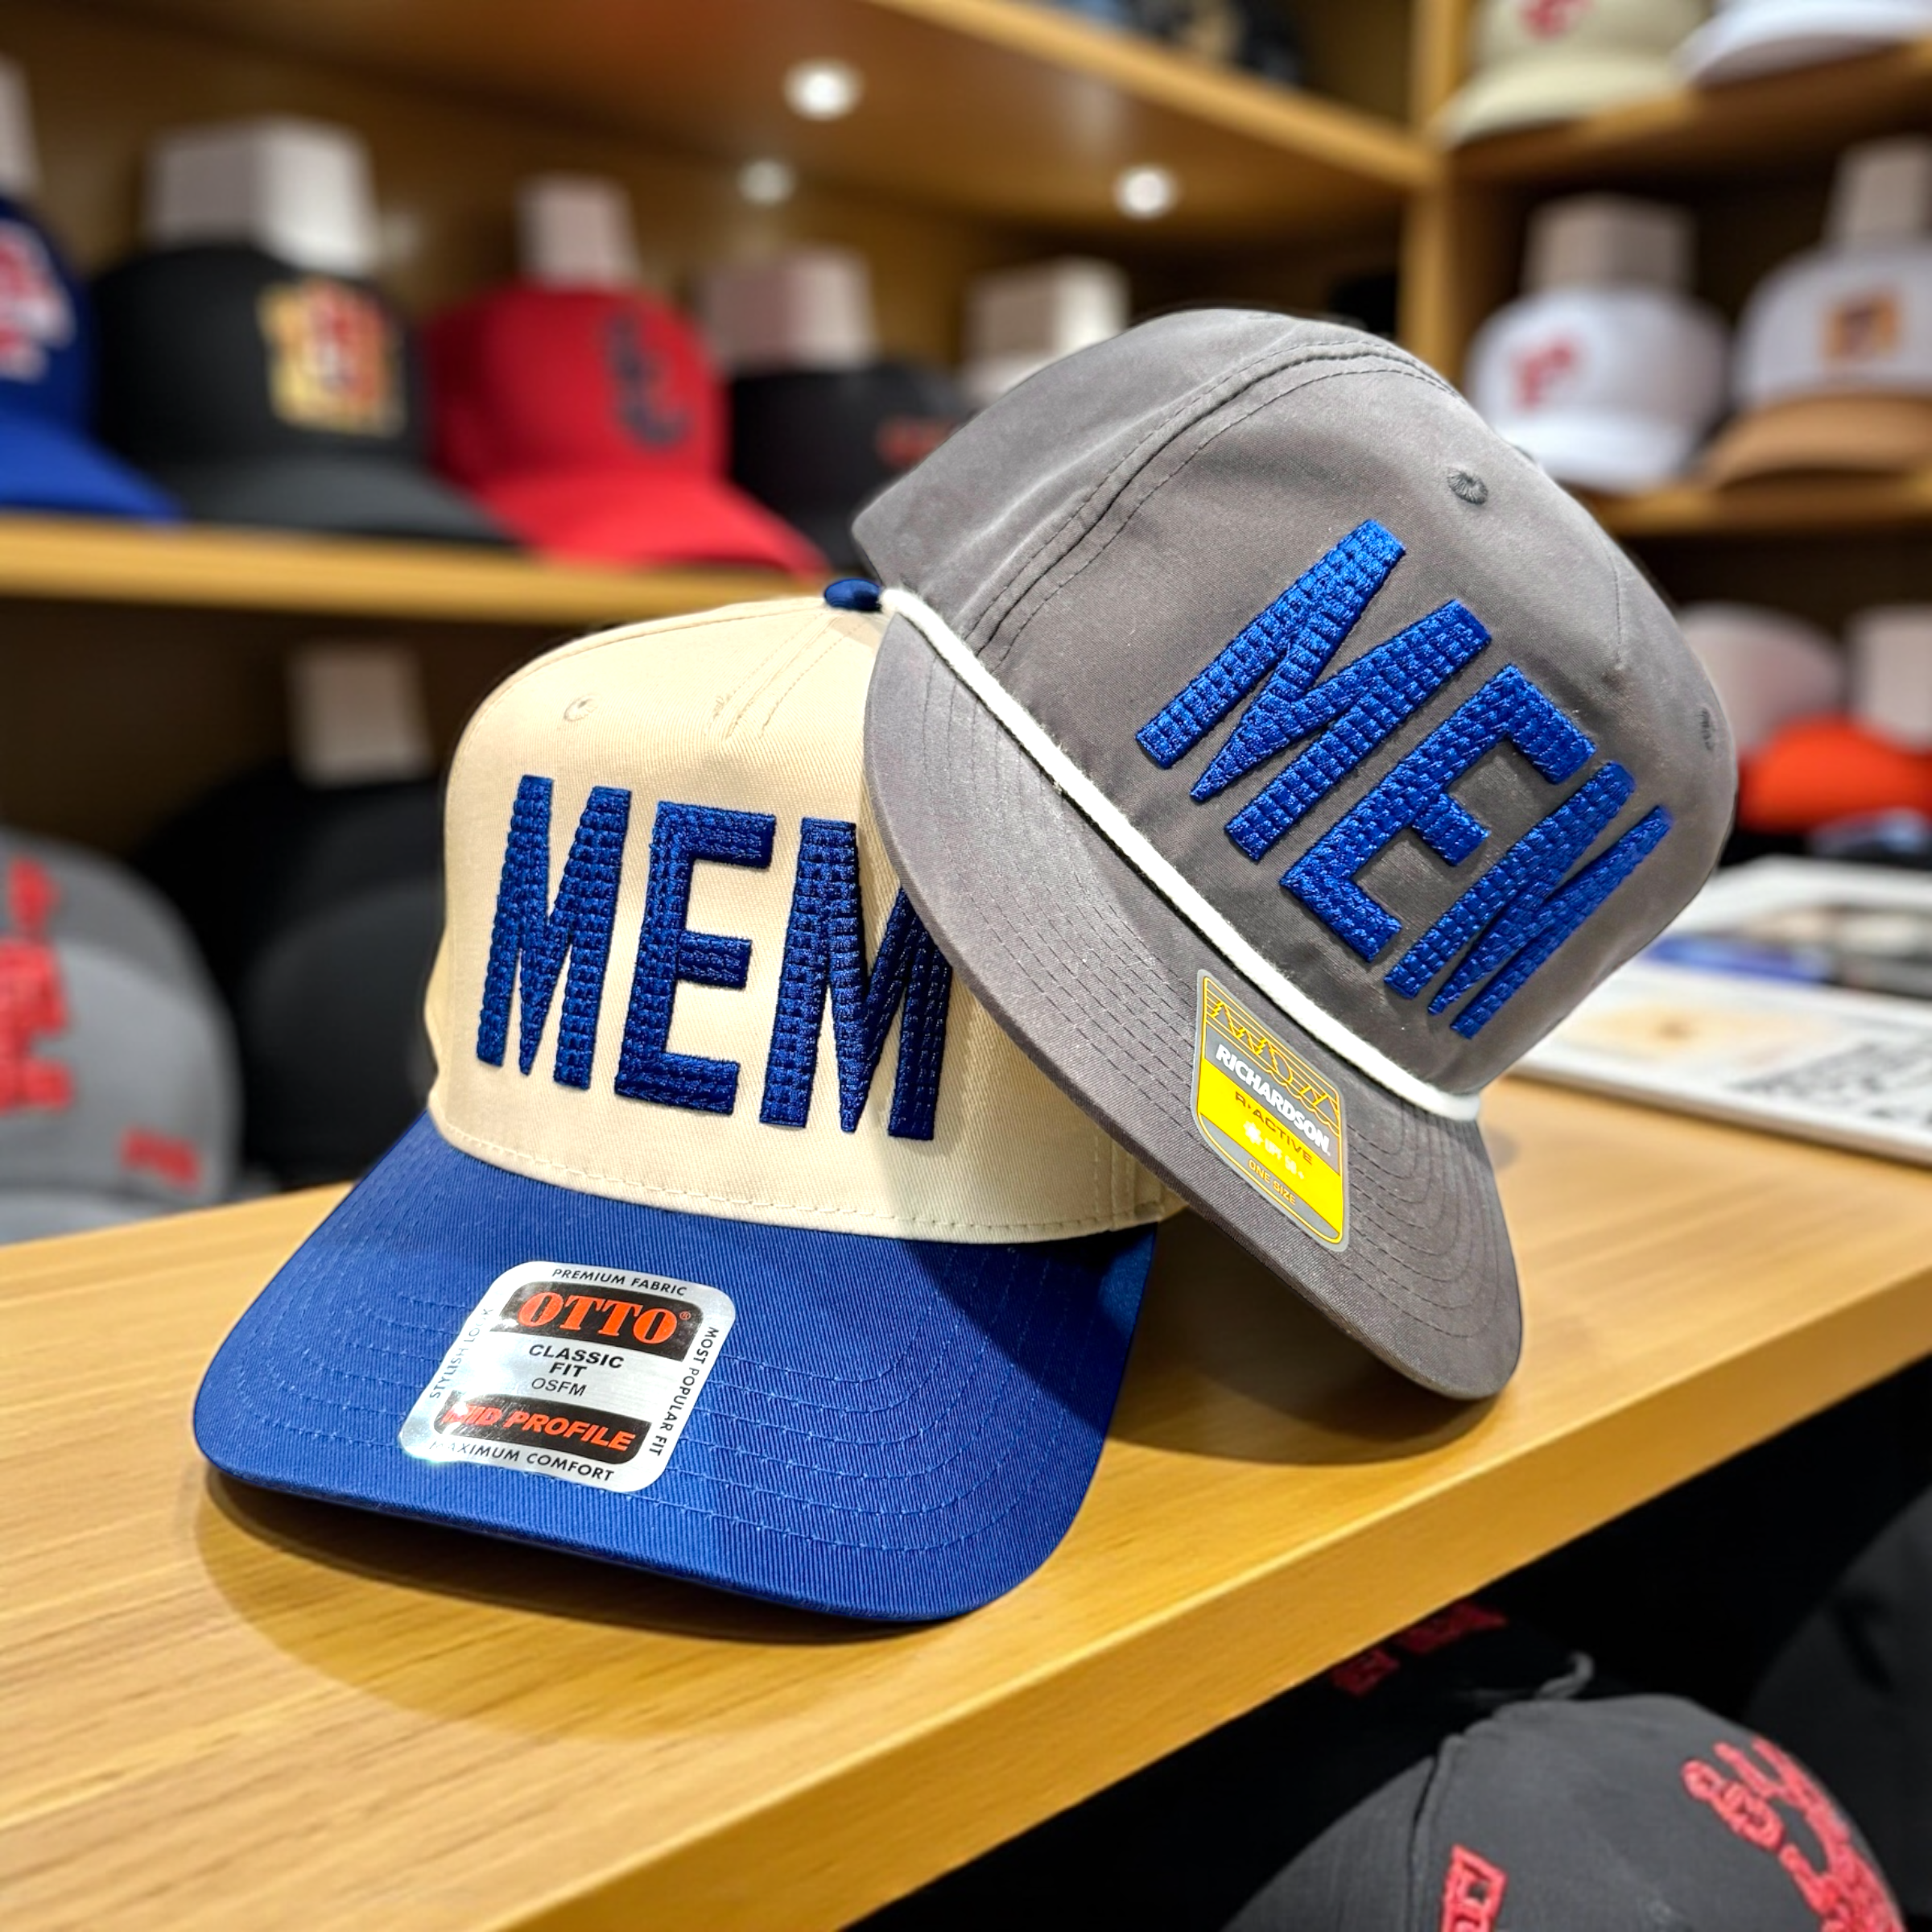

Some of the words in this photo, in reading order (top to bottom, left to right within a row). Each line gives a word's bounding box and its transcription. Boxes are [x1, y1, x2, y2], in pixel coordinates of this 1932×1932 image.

[1135, 518, 1674, 1039] MEM
[477, 774, 953, 1141] MEM
[1216, 1044, 1330, 1154] RICHARDSON
[1249, 1159, 1270, 1183] ONE
[1273, 1180, 1296, 1206] SIZE
[551, 1268, 626, 1285] PREMIUM
[631, 1278, 687, 1296] FABRIC
[528, 1344, 624, 1368] CLASSIC
[692, 1327, 719, 1364] MOST
[429, 1348, 469, 1398] STYLISH
[531, 1377, 587, 1397] OSFM
[549, 1362, 588, 1377] FIT
[659, 1367, 700, 1432] POPULAR
[503, 1410, 636, 1451] PROFILE
[649, 1435, 667, 1456] FIT
[526, 1453, 614, 1481] COMFORT
